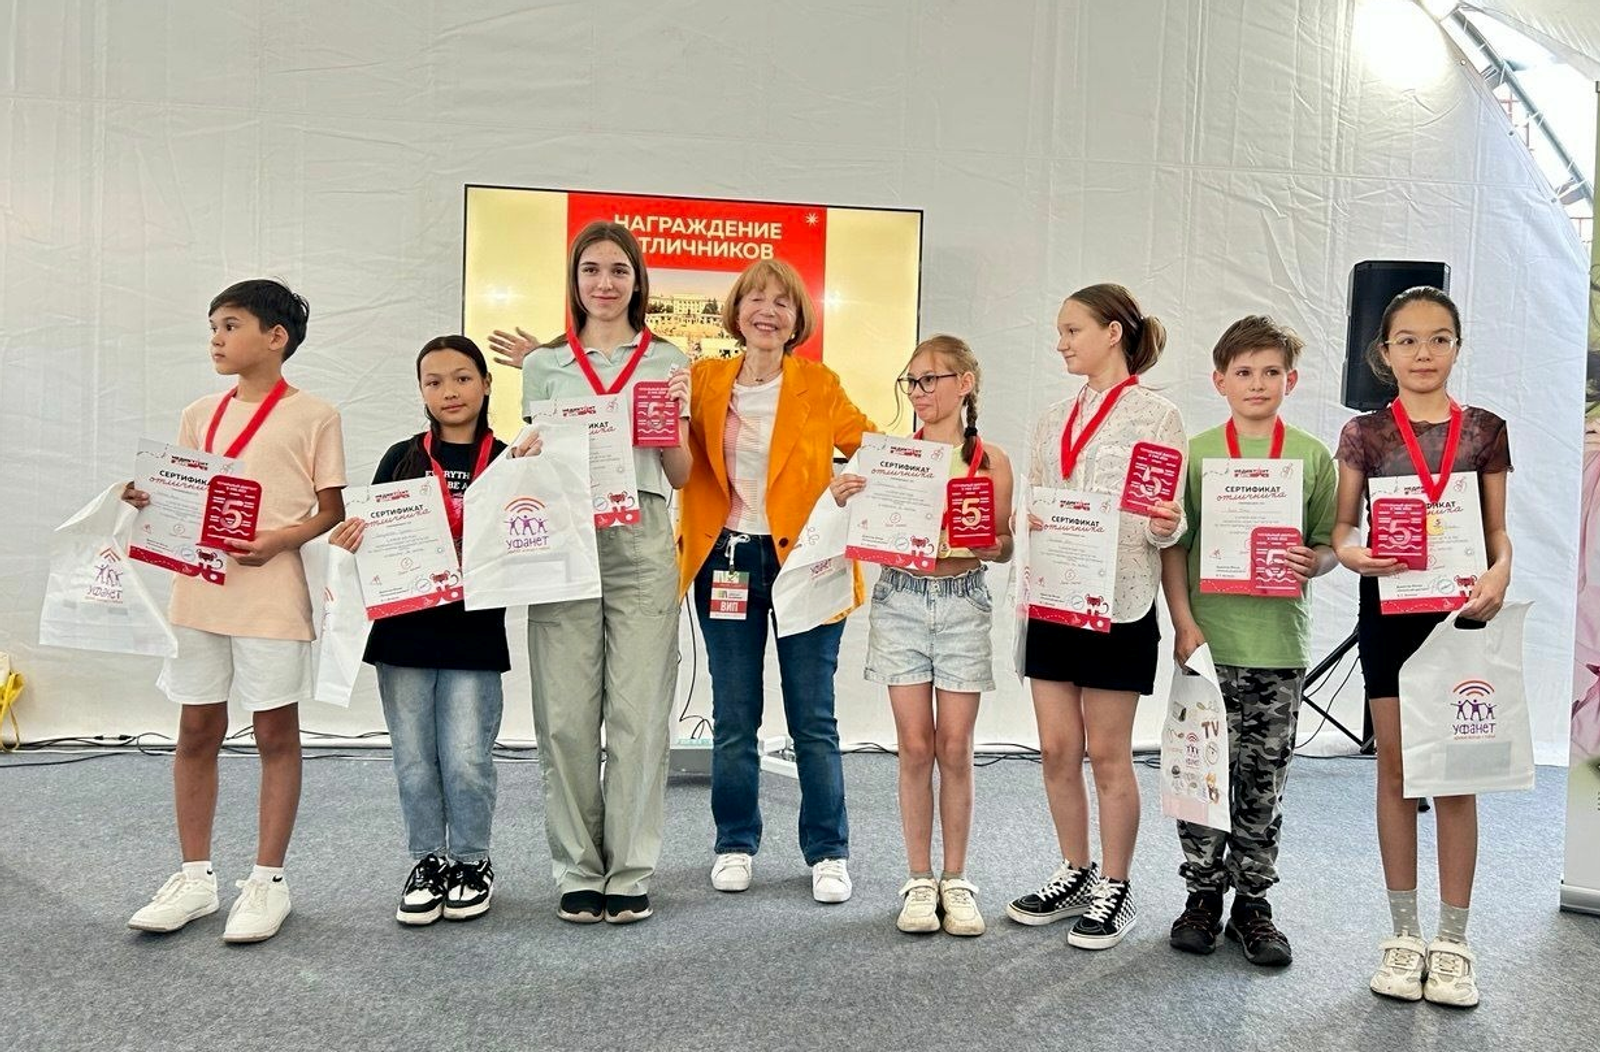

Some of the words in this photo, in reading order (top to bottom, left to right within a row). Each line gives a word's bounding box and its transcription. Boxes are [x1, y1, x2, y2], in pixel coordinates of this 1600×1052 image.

[614, 214, 782, 239] НАГРАЖДЕНИЕ
[638, 236, 774, 260] ТЛИЧНИКОВ
[880, 460, 931, 473] СЕРТИФИКАТ
[159, 469, 210, 486] СЕРТИФИК
[1139, 466, 1165, 497] 5
[1224, 485, 1281, 493] СЕРТИФИКАТ
[220, 500, 243, 529] 5
[370, 504, 423, 519] СЕРТИФИКАТ
[961, 498, 982, 527] 5
[1051, 515, 1100, 527] СЕРТИФИКАТ
[1388, 519, 1412, 546] 5
[1265, 549, 1287, 578] 5
[720, 601, 738, 612] ВИП
[1202, 721, 1220, 740] TV
